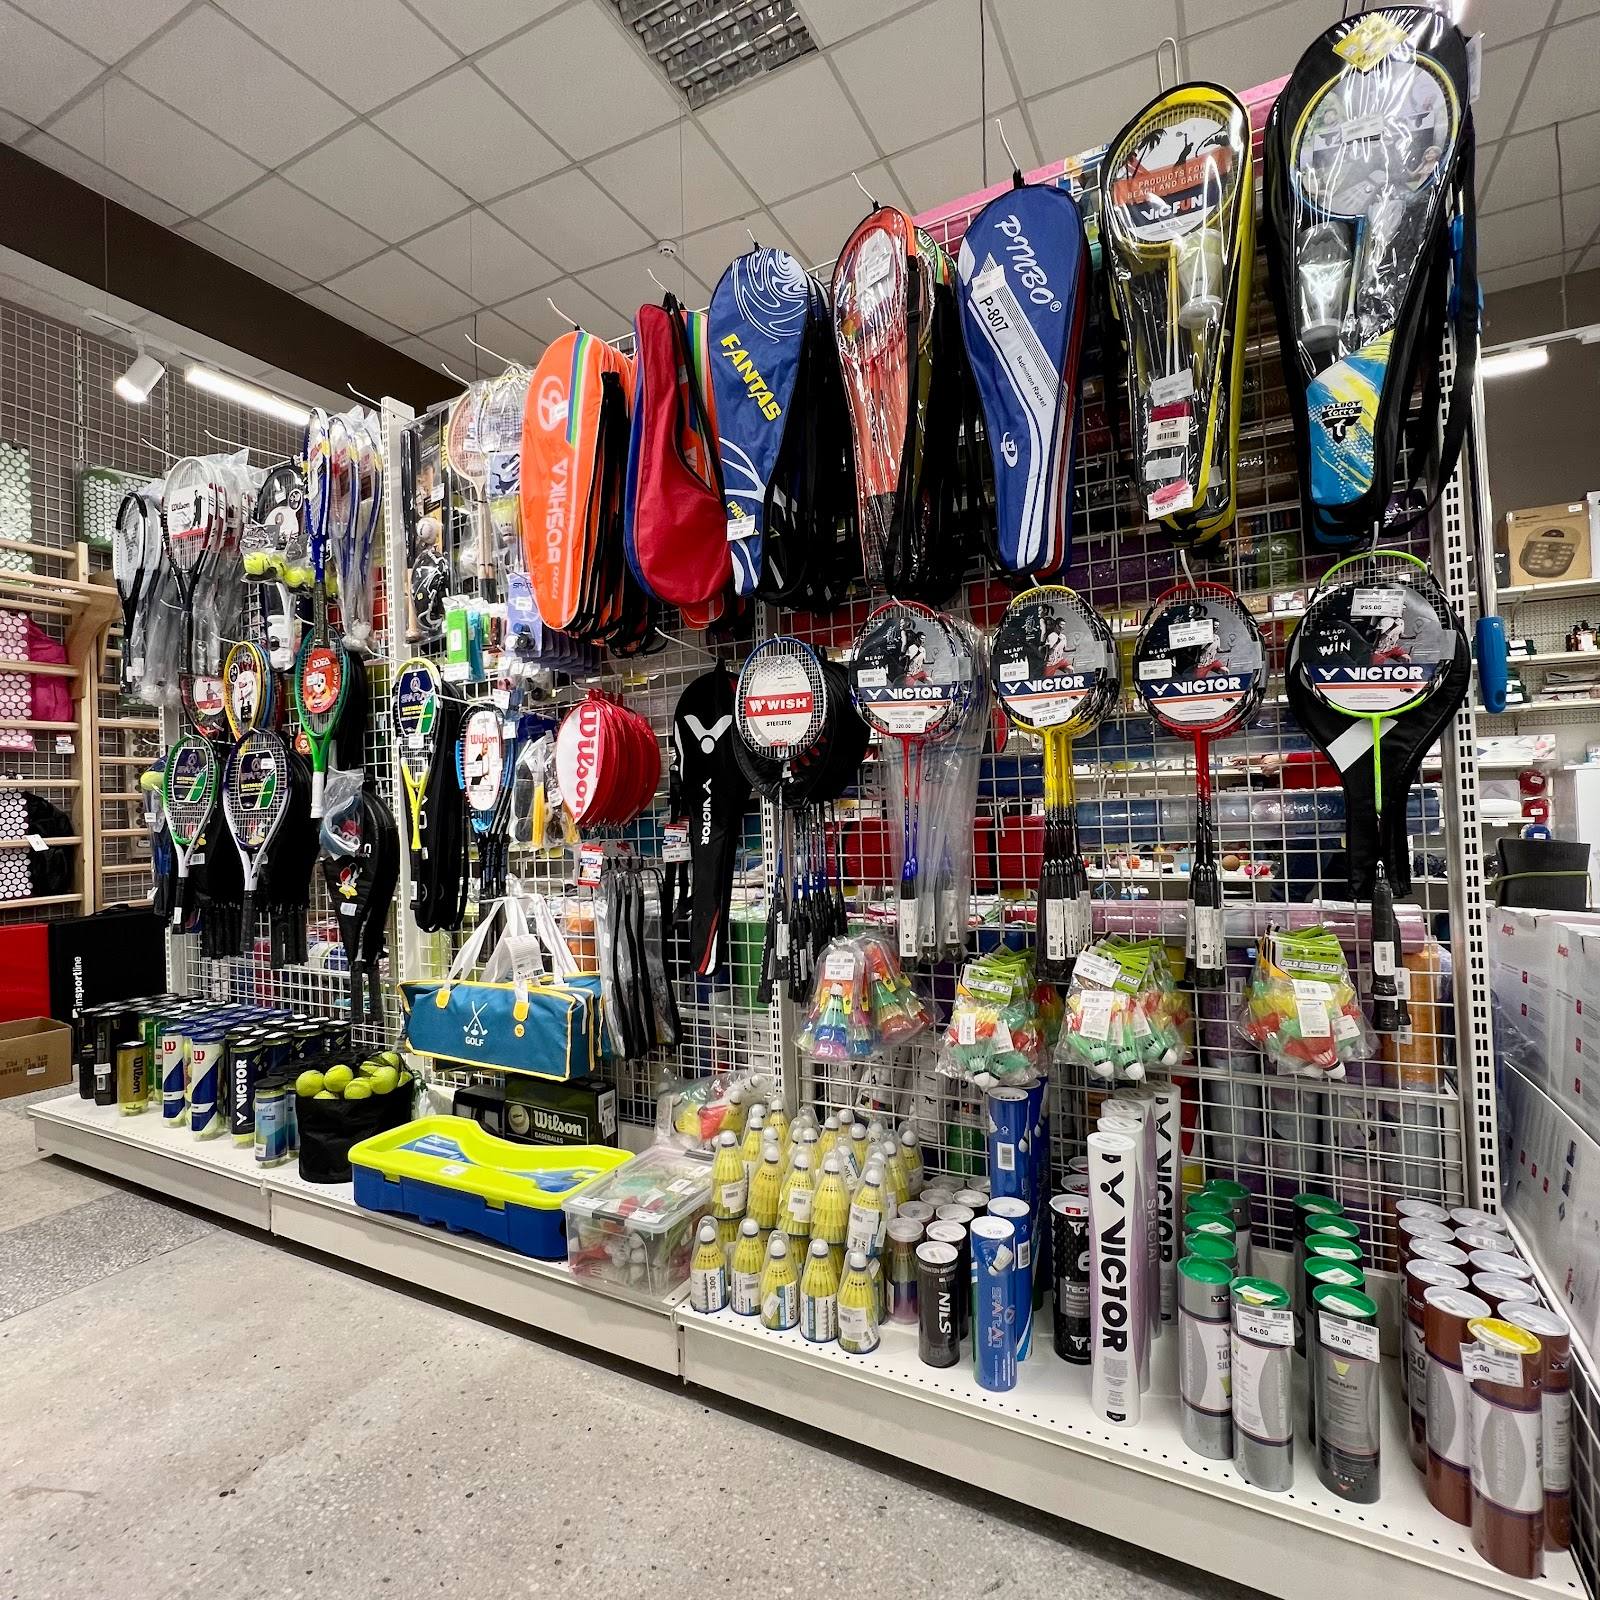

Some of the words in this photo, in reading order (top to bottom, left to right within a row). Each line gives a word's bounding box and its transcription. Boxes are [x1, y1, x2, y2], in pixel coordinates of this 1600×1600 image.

[1127, 186, 1156, 199] BEACH
[1159, 181, 1177, 191] AND
[1138, 169, 1185, 189] PRODUCTS
[979, 295, 1009, 334] P-807
[720, 333, 782, 422] FANTAS
[1016, 355, 1036, 388] Badminton
[1030, 384, 1047, 408] Racket
[546, 457, 569, 564] BOSHIKA
[1318, 640, 1350, 656] WIN
[1024, 676, 1084, 692] VICTOR
[1344, 666, 1423, 681] VICTOR
[885, 687, 942, 699] VICTOR
[1172, 677, 1241, 694] VICTOR
[766, 698, 807, 710] WISH
[470, 733, 498, 744] Wilson
[576, 705, 597, 818] Wilson
[701, 797, 711, 845] VICTOR
[73, 956, 84, 1006] insportline
[465, 1036, 485, 1046] GOLF
[133, 1056, 143, 1093] Wilson
[236, 1059, 248, 1110] VICTOR
[533, 1110, 584, 1137] Wilson
[1100, 1215, 1128, 1354] VICTOR
[938, 1292, 952, 1334] NILS
[1249, 1326, 1269, 1336] 45.00
[1330, 1334, 1352, 1346] 50.00
